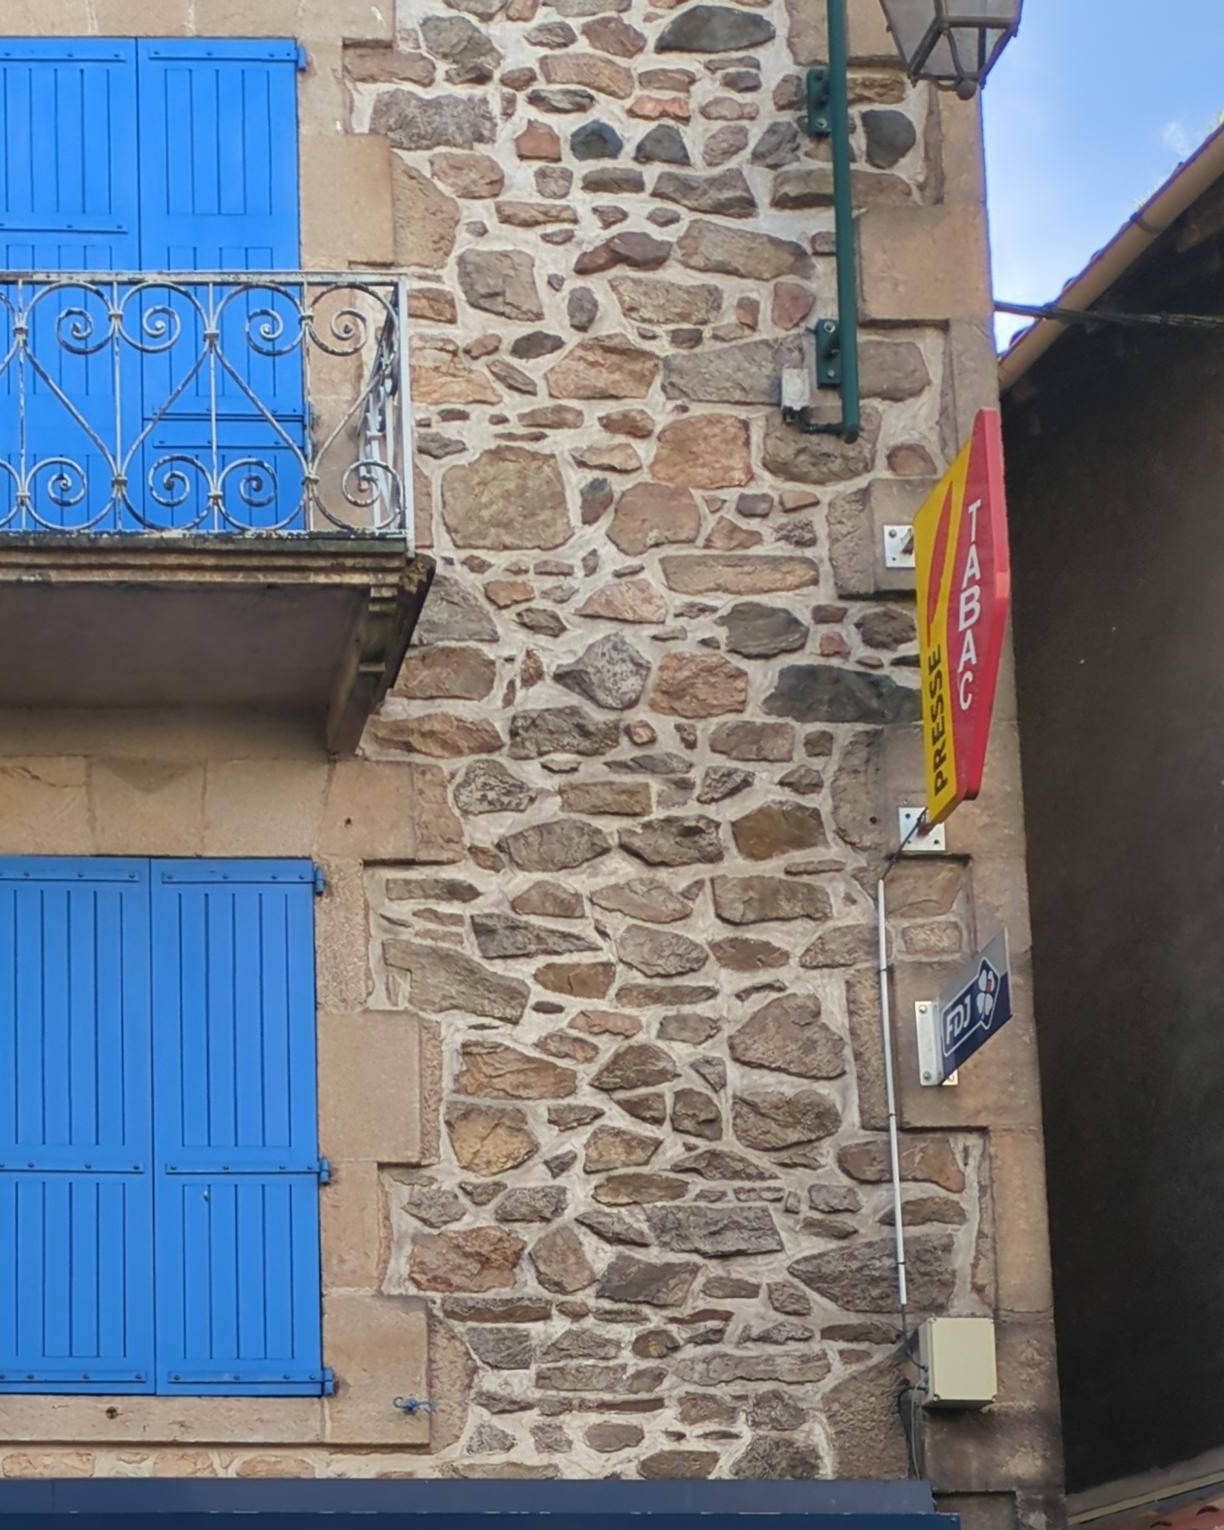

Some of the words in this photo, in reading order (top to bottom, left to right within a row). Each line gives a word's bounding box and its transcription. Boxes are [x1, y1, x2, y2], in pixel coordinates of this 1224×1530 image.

[958, 499, 981, 711] TABAC
[928, 644, 950, 796] PRESSE
[946, 994, 971, 1046] FDJ
